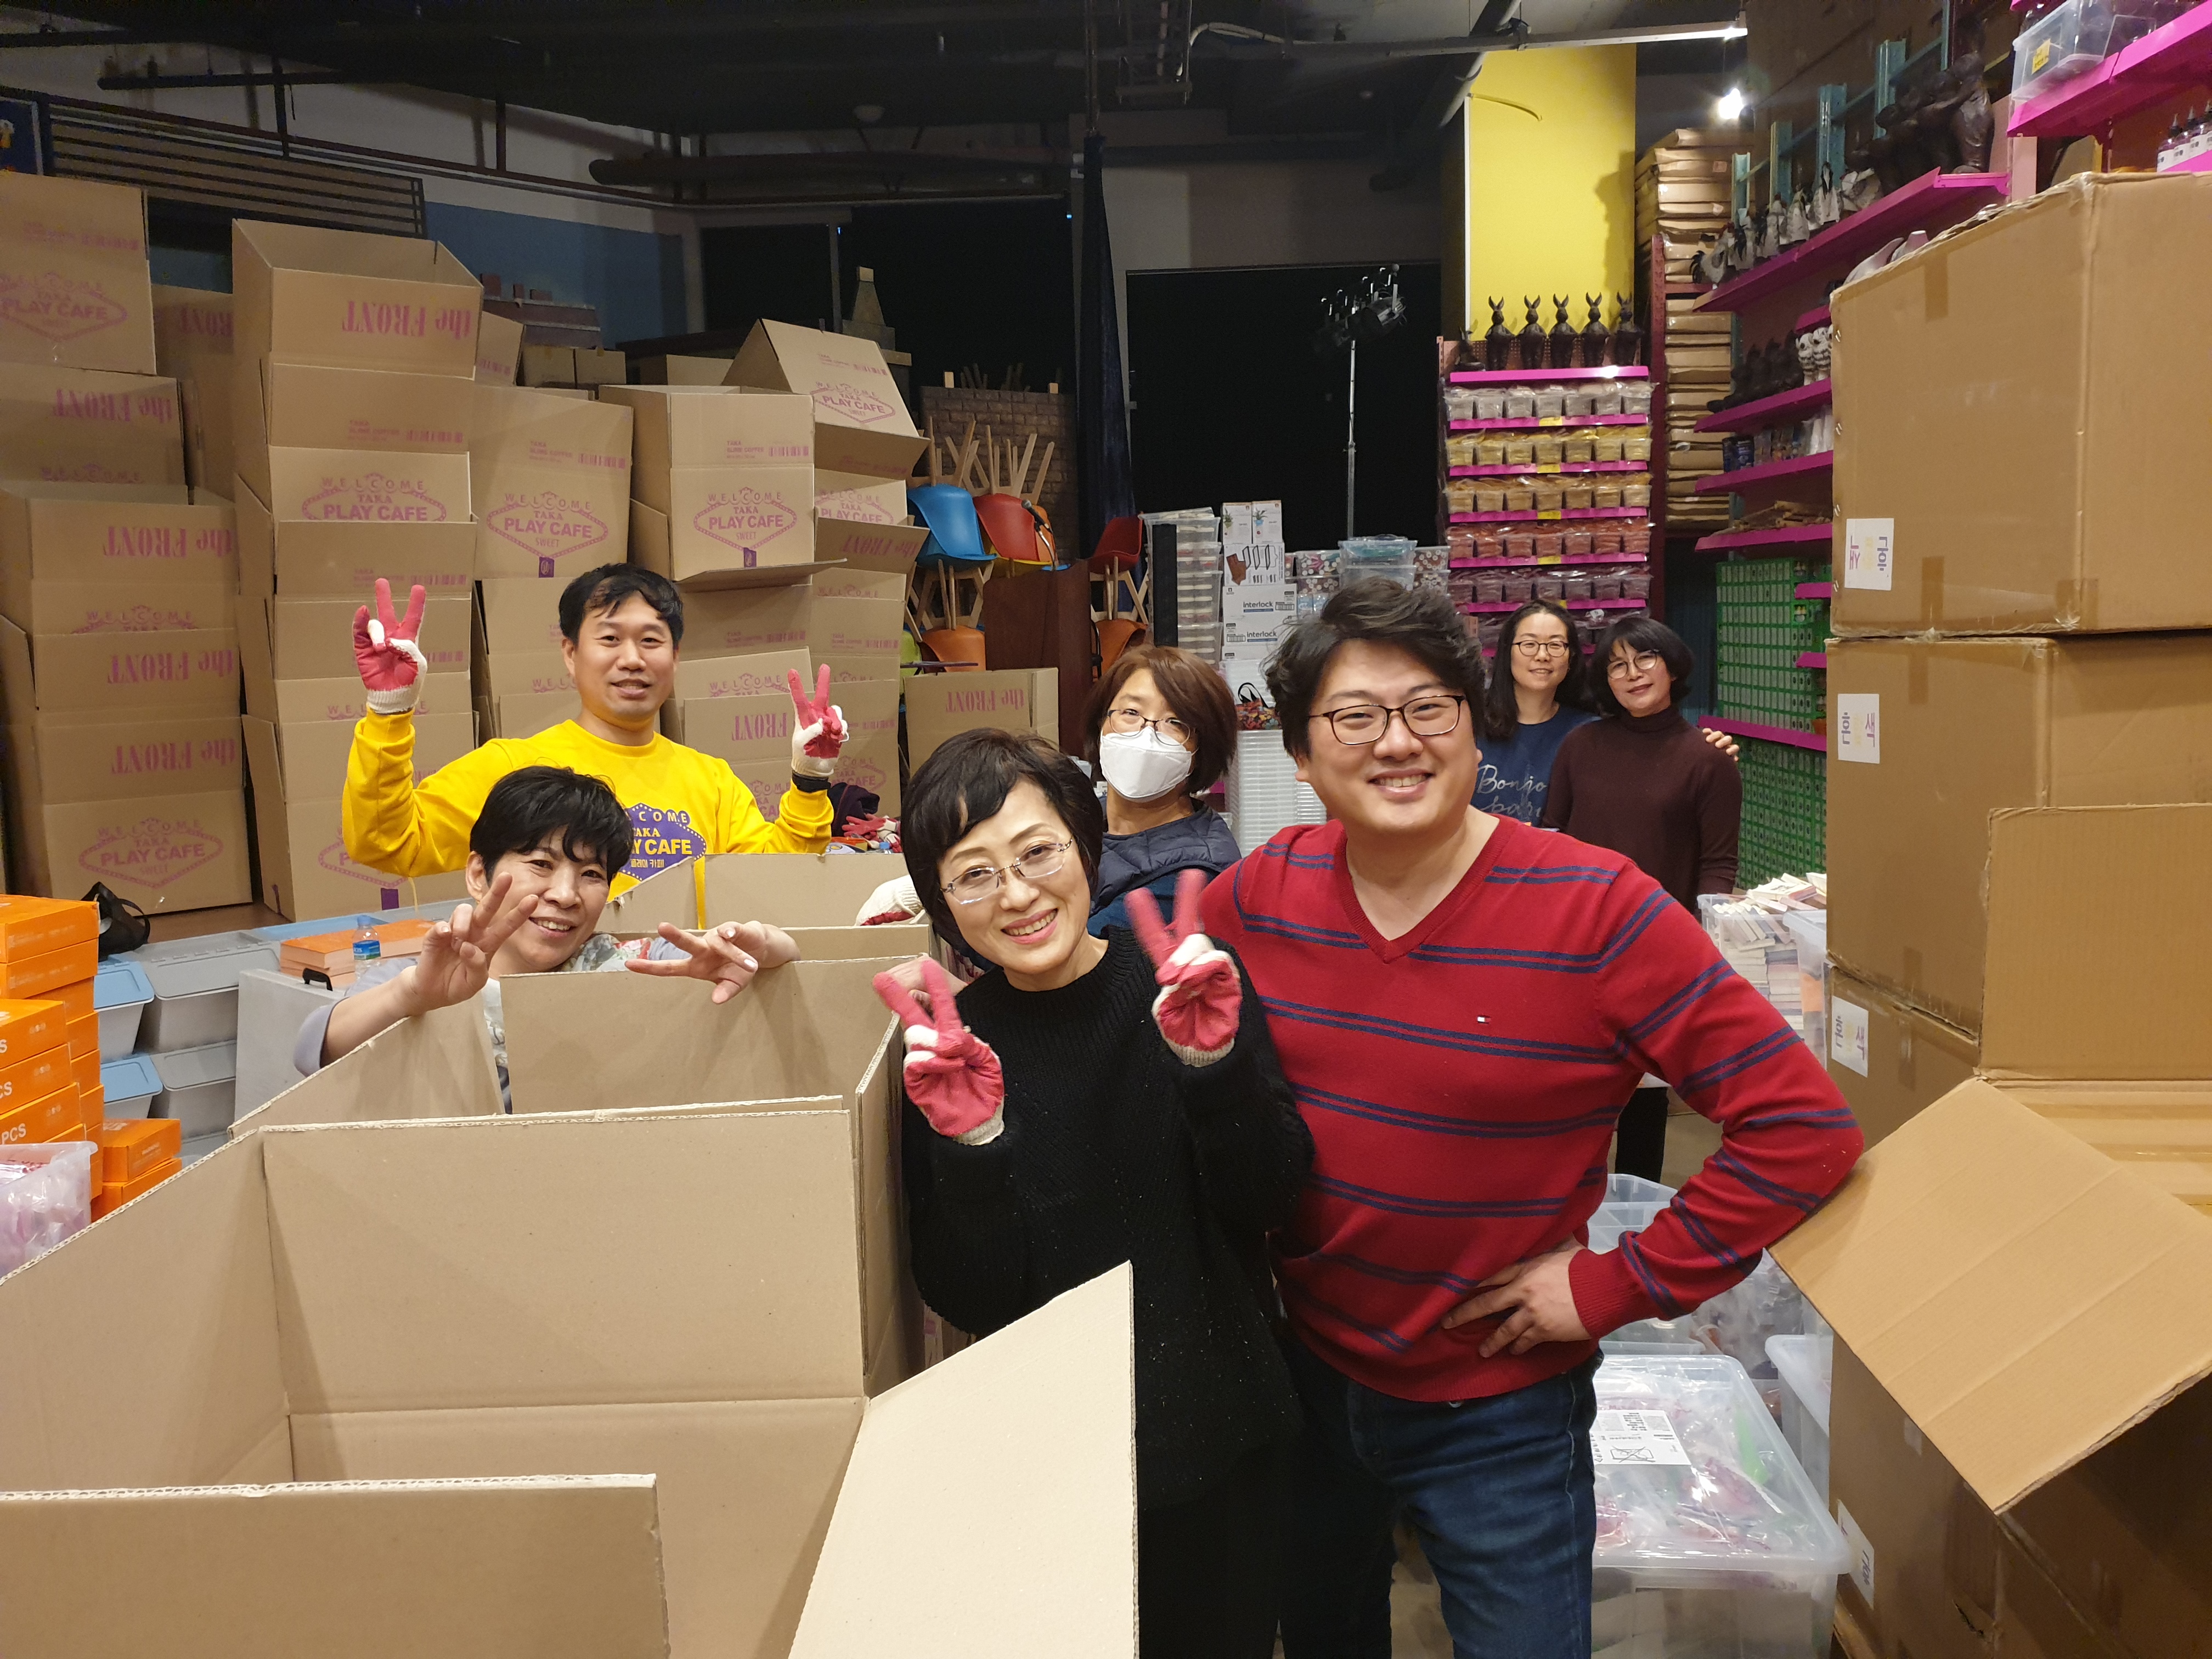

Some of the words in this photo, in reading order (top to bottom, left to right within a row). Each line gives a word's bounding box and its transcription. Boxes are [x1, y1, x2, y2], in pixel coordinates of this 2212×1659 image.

[57, 303, 107, 319] CAFE
[342, 301, 426, 337] FRONT
[436, 308, 471, 340] the
[822, 396, 851, 407] PLAY
[855, 401, 885, 414] CAFE
[322, 478, 425, 490] WELCOME
[359, 495, 393, 504] TAKA
[505, 493, 592, 510] WELCOME
[708, 493, 782, 502] WELCOME
[324, 505, 373, 520] PLAY
[377, 506, 427, 521] CAFE
[534, 511, 563, 521] TAKA
[504, 517, 546, 534] PLAY
[550, 522, 592, 538] CAFE
[709, 516, 746, 530] PLAY
[748, 515, 784, 528] CAFE
[103, 527, 187, 557] FRONT
[737, 532, 757, 540] SWEET
[108, 651, 190, 684] FRONT
[710, 675, 781, 690] WELCOME
[945, 690, 996, 712] FRONT
[1001, 688, 1024, 710] the
[732, 713, 787, 741] FRONT
[111, 742, 191, 774] FRONT
[639, 811, 688, 823] COME
[101, 849, 150, 867] PLAY
[155, 844, 205, 861] CAFE
[645, 839, 692, 855] CAFE
[2, 1123, 26, 1145] PCS
